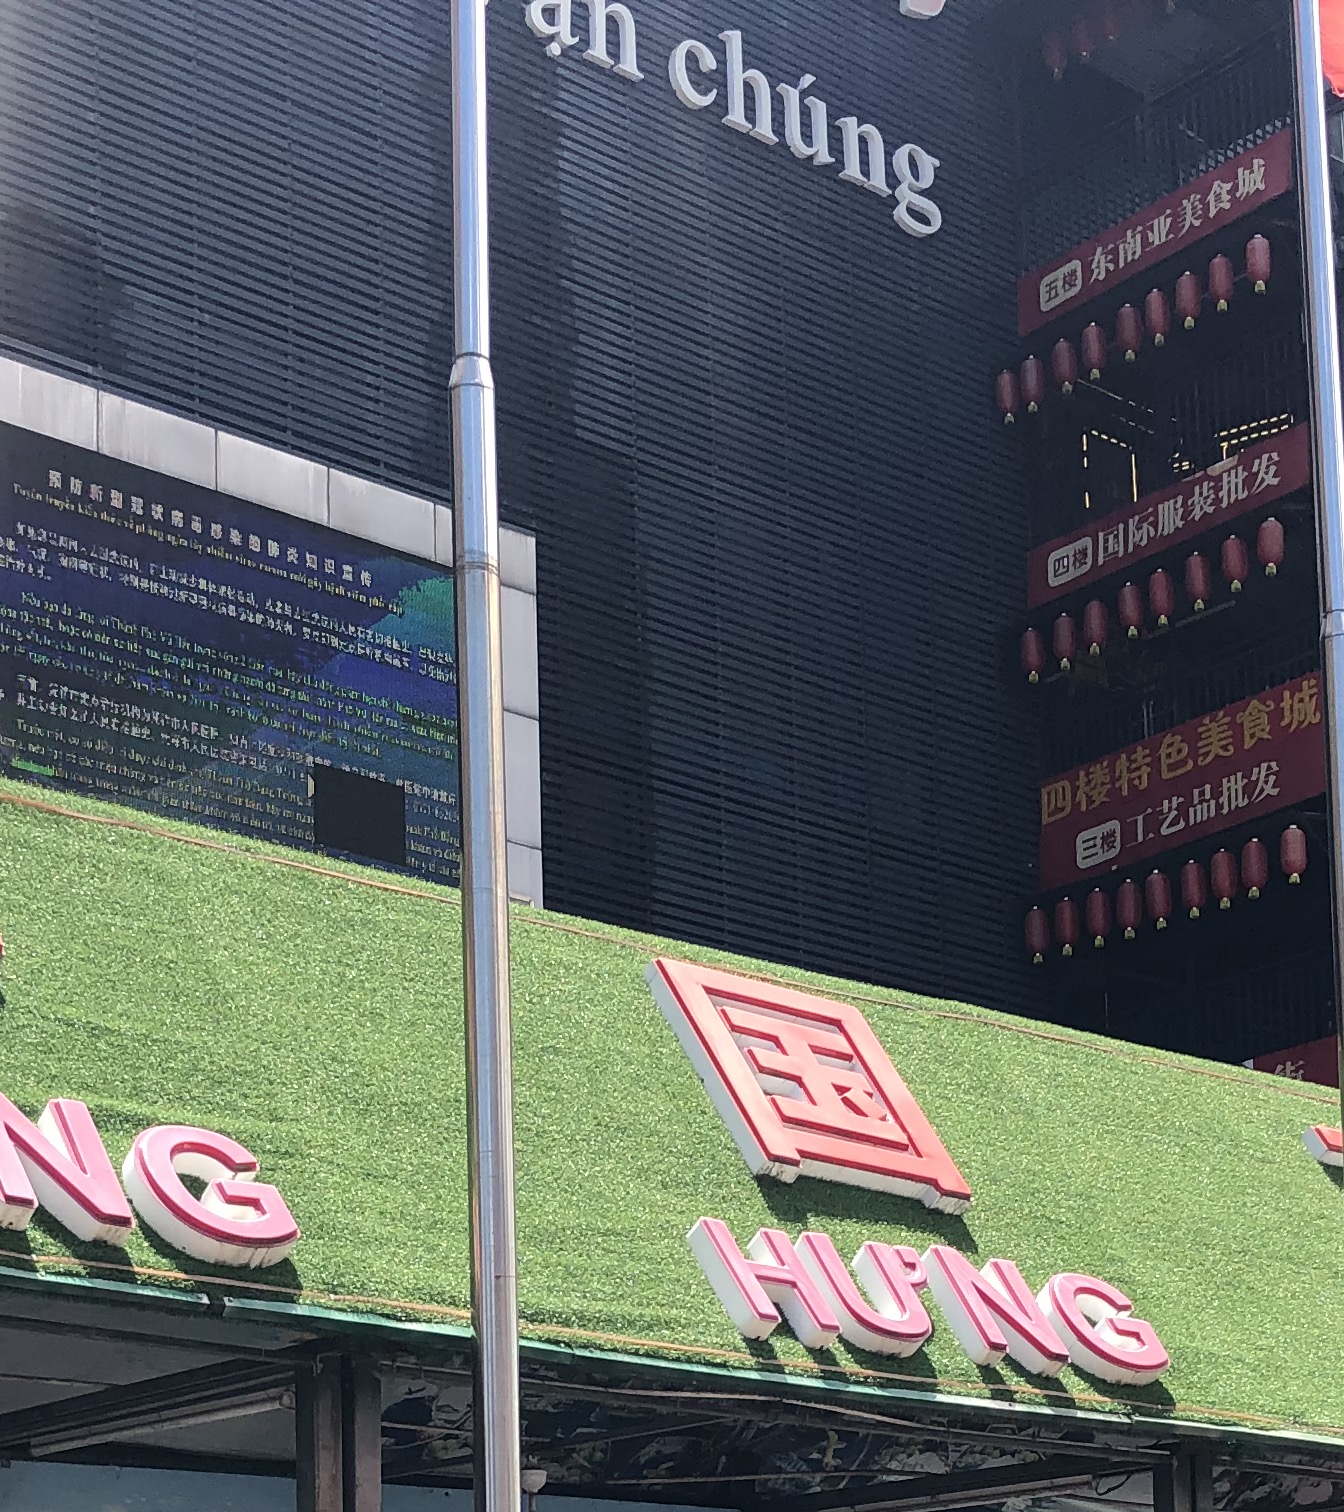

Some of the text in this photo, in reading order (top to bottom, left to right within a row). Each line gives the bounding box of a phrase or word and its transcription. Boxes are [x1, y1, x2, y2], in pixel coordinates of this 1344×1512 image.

[669, 30, 942, 237] chúng
[1042, 158, 1268, 305] 五楼 东南亚美食城
[1051, 451, 1284, 580] 四楼 国际服装批发
[1042, 679, 1322, 825] 四楼特色美食城
[1080, 761, 1282, 863] 三楼 工艺品批发
[687, 1217, 1170, 1386] HƯNG
